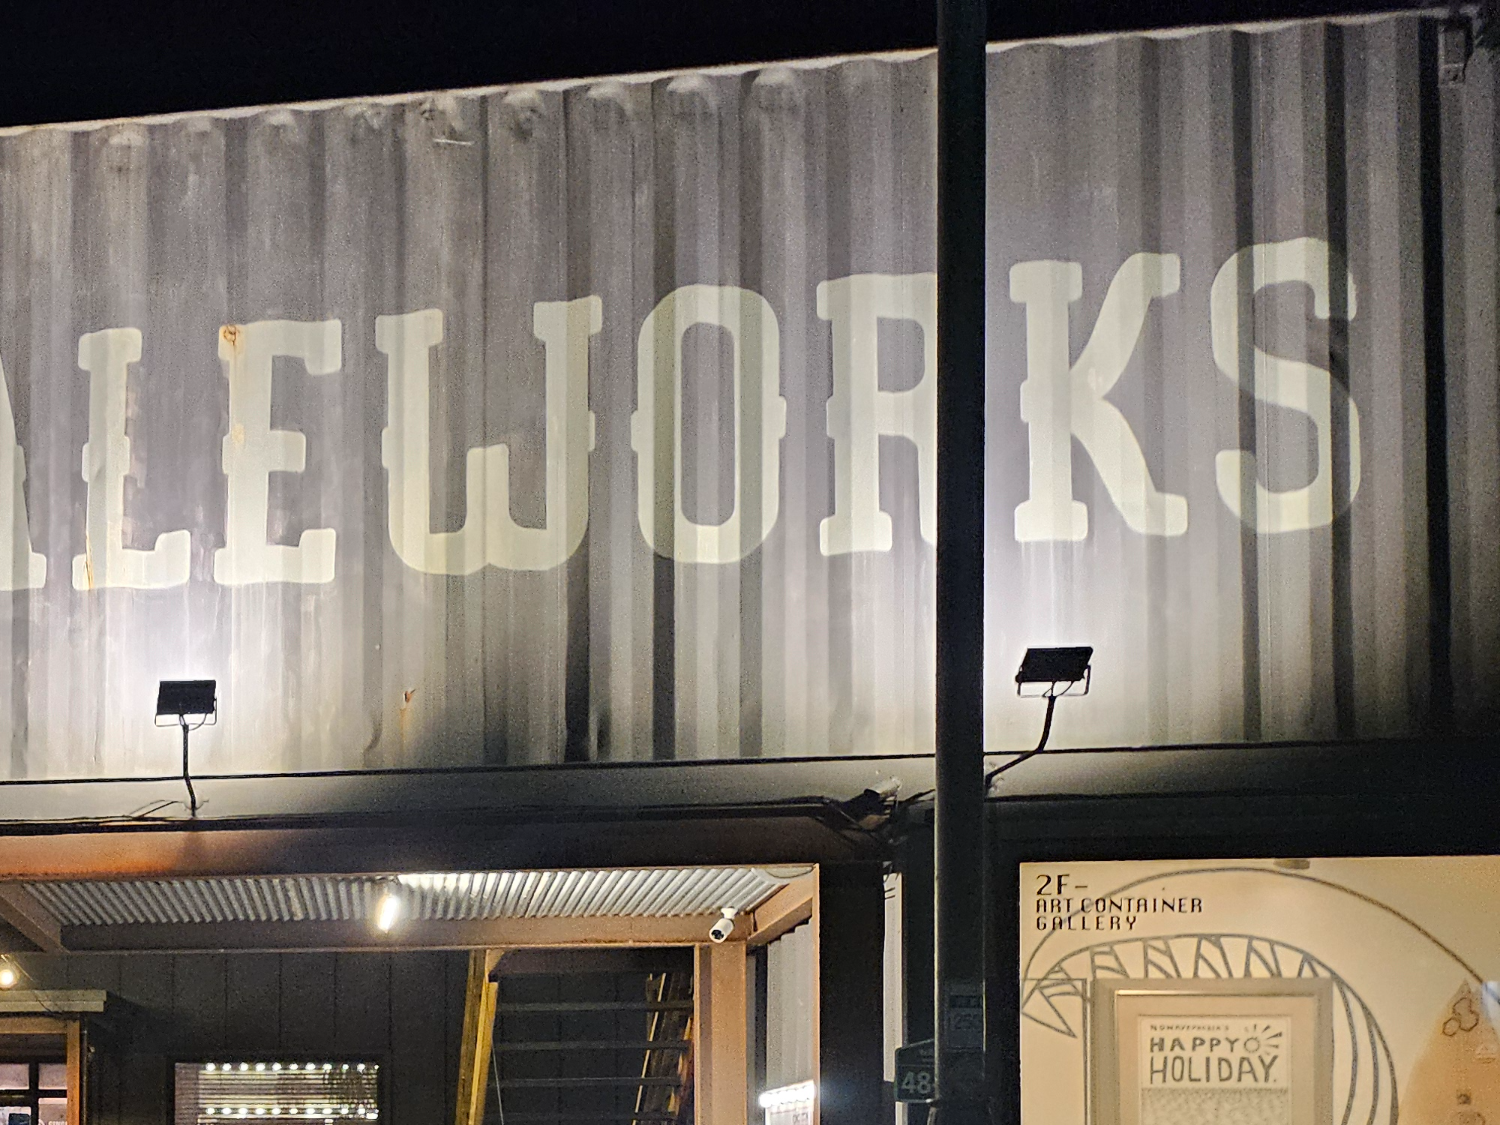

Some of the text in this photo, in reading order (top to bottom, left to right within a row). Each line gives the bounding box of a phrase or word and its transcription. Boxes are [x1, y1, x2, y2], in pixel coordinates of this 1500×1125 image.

[1036, 897, 1202, 913] ART CONTAINER
[1036, 915, 1137, 930] GALLERY
[1149, 1036, 1239, 1053] HAPPY
[902, 1071, 931, 1094] 48
